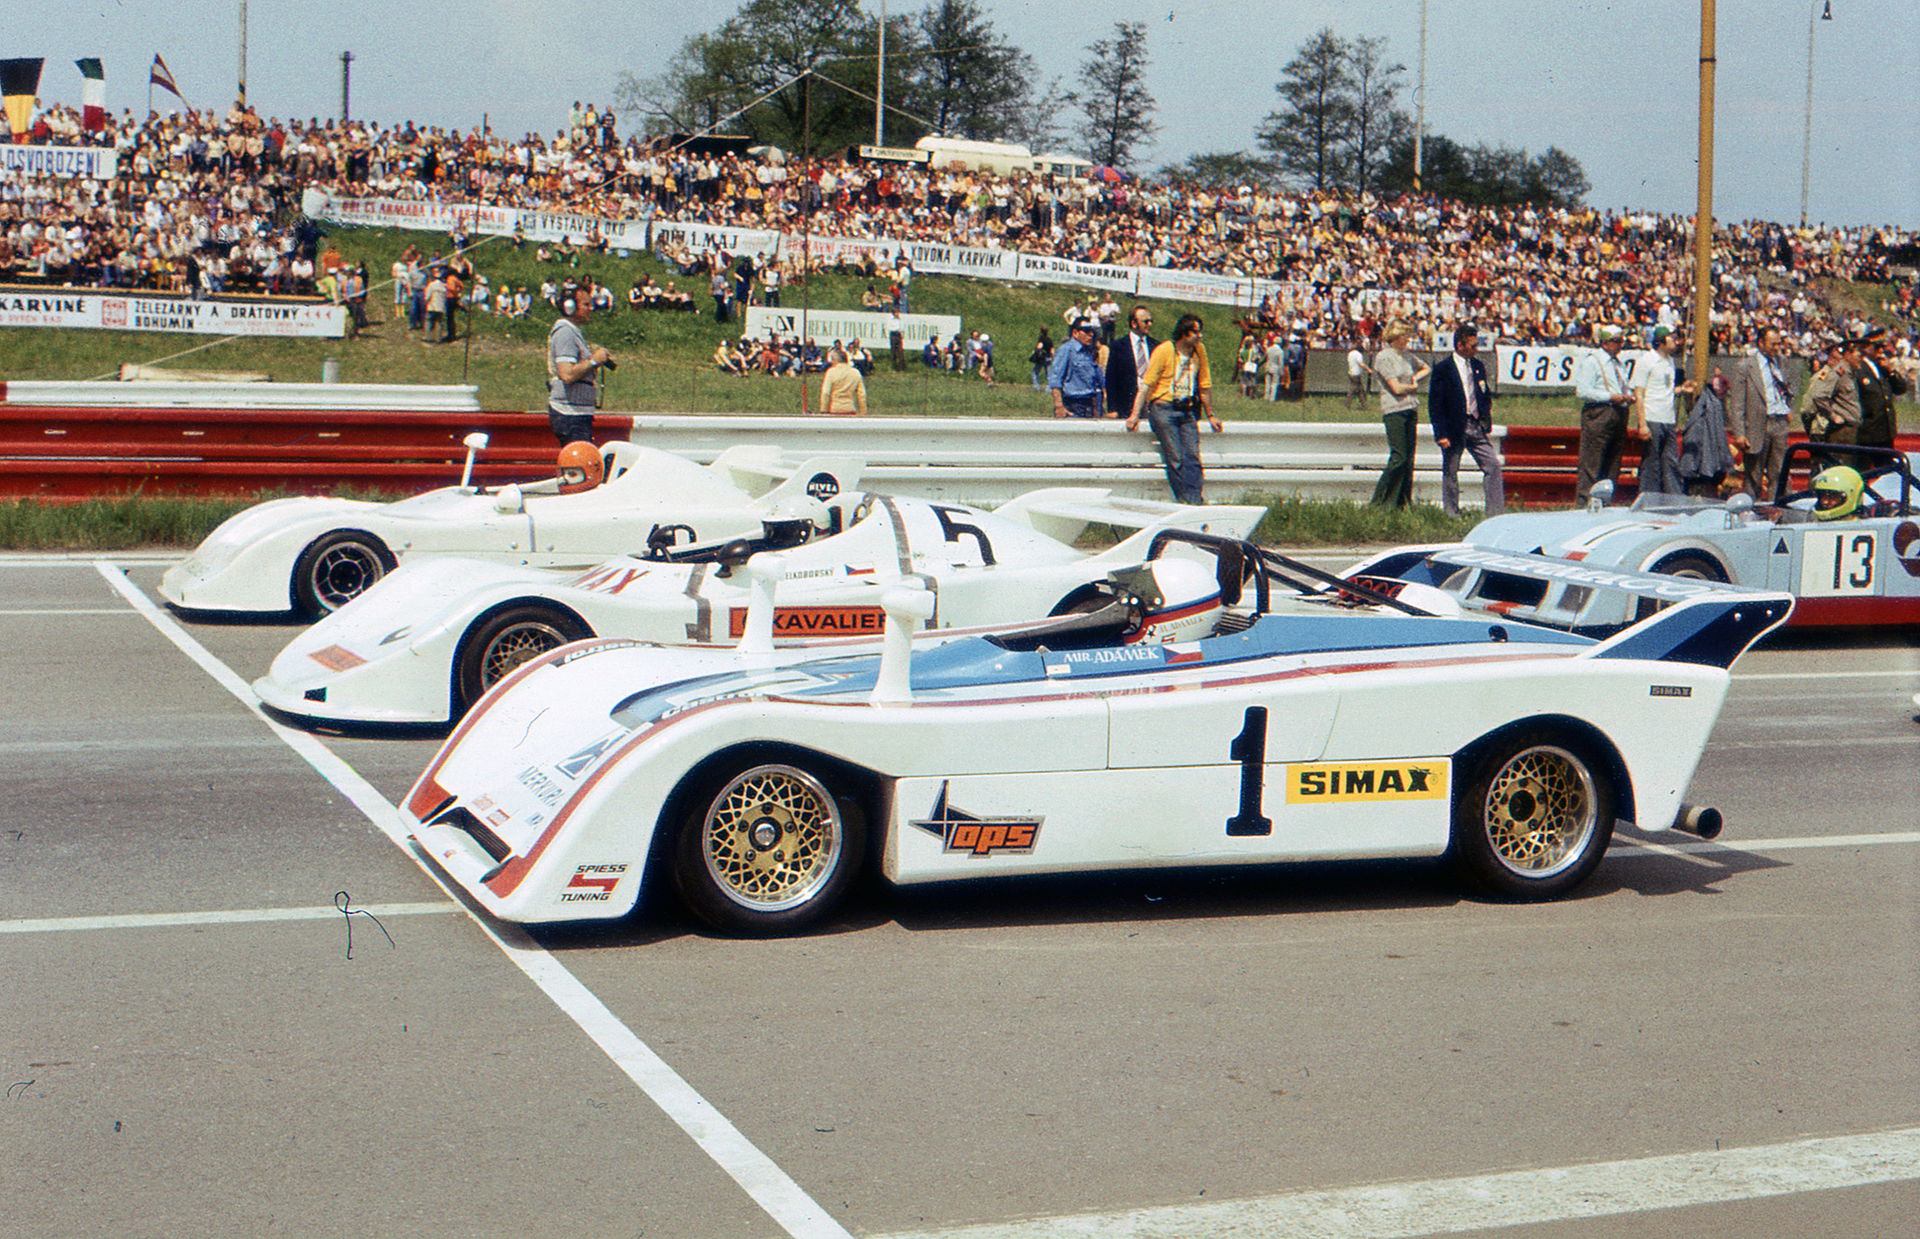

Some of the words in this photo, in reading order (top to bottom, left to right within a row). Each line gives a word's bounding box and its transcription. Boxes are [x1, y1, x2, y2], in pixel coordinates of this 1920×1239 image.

[808, 483, 838, 493] NIVEA
[929, 504, 998, 568] 5
[1833, 534, 1876, 590] 13
[1651, 686, 1691, 697] SIMAX
[1225, 705, 1274, 837] 1
[1300, 768, 1431, 796] SIMAX
[576, 864, 628, 874] SPIESS
[560, 892, 612, 902] TUNING
